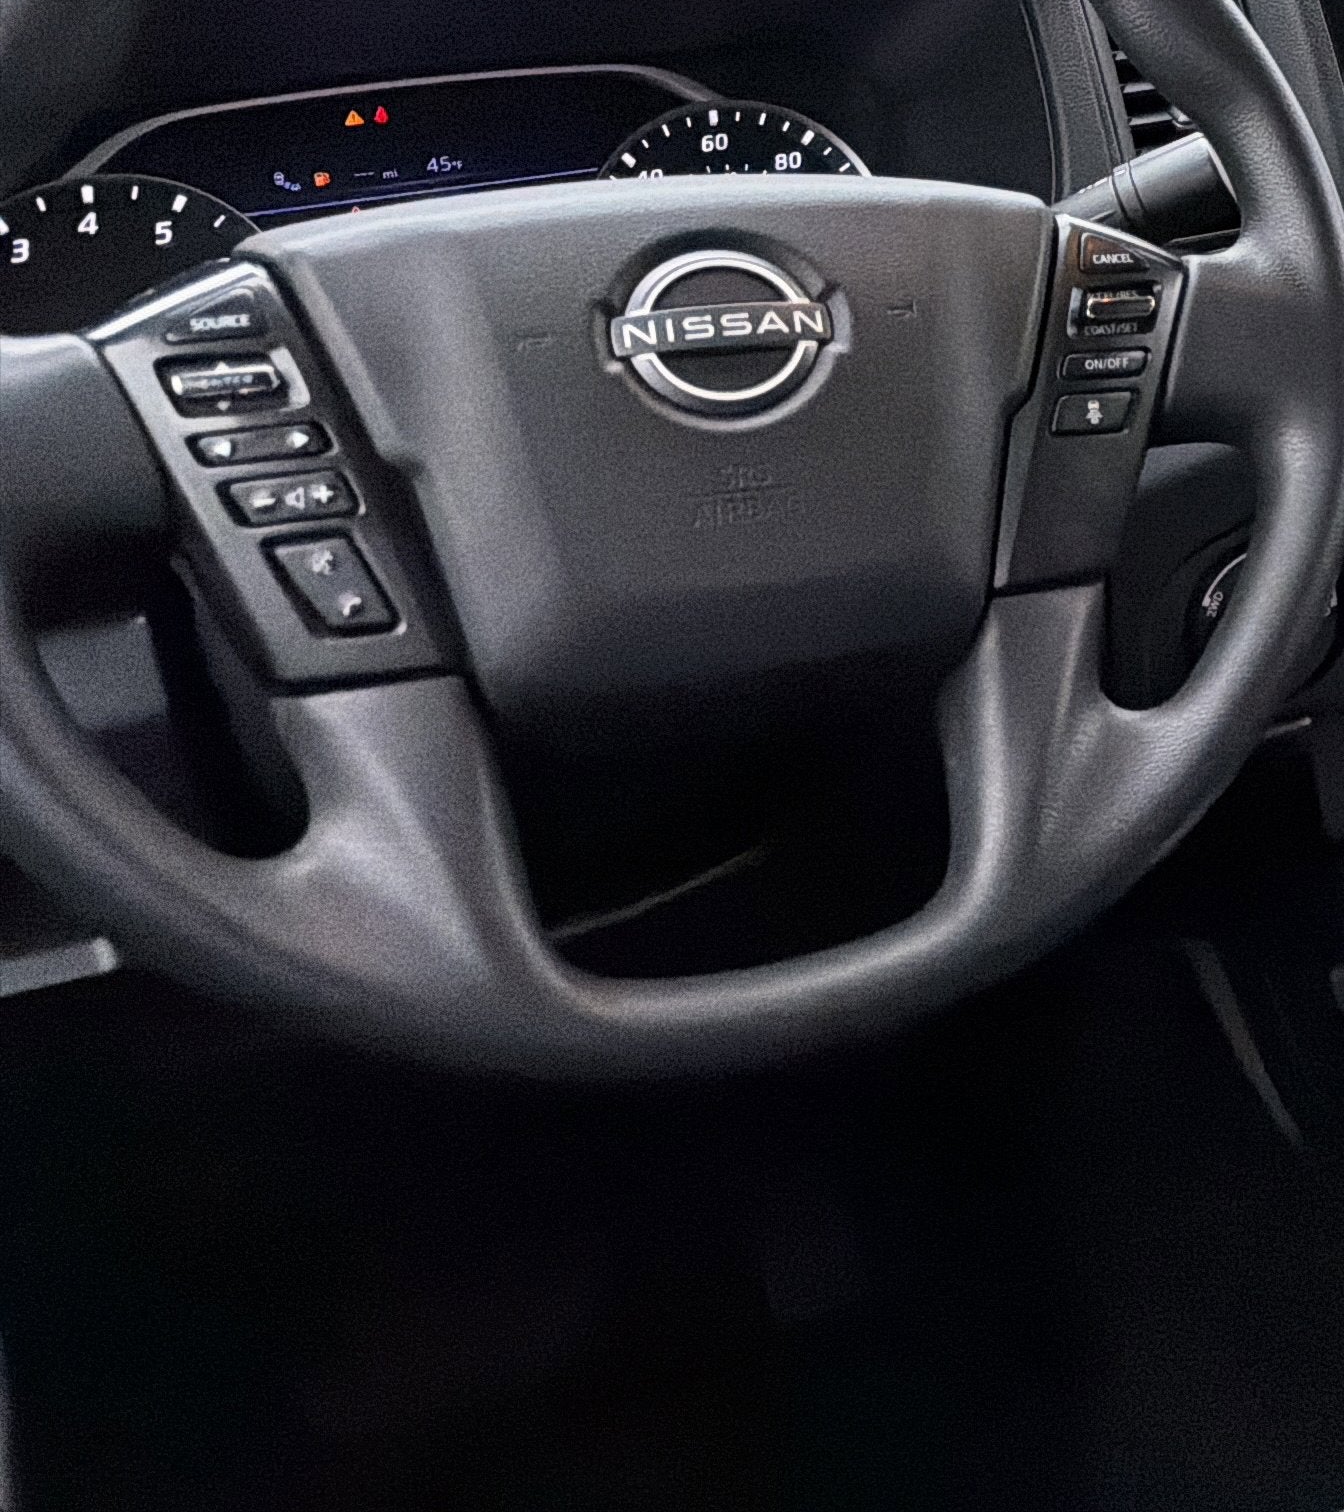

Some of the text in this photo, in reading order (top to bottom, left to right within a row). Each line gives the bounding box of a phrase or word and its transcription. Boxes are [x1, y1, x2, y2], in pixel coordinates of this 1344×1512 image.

[701, 133, 729, 153] 60
[774, 151, 802, 171] 80
[382, 168, 399, 179] mi
[77, 211, 99, 235] 4
[155, 220, 173, 245] 5
[10, 238, 30, 264] 3
[1092, 253, 1134, 265] CANCEL
[189, 313, 252, 332] SOURCE
[621, 309, 825, 349] NISSAN
[1084, 357, 1129, 370] ON/OFF
